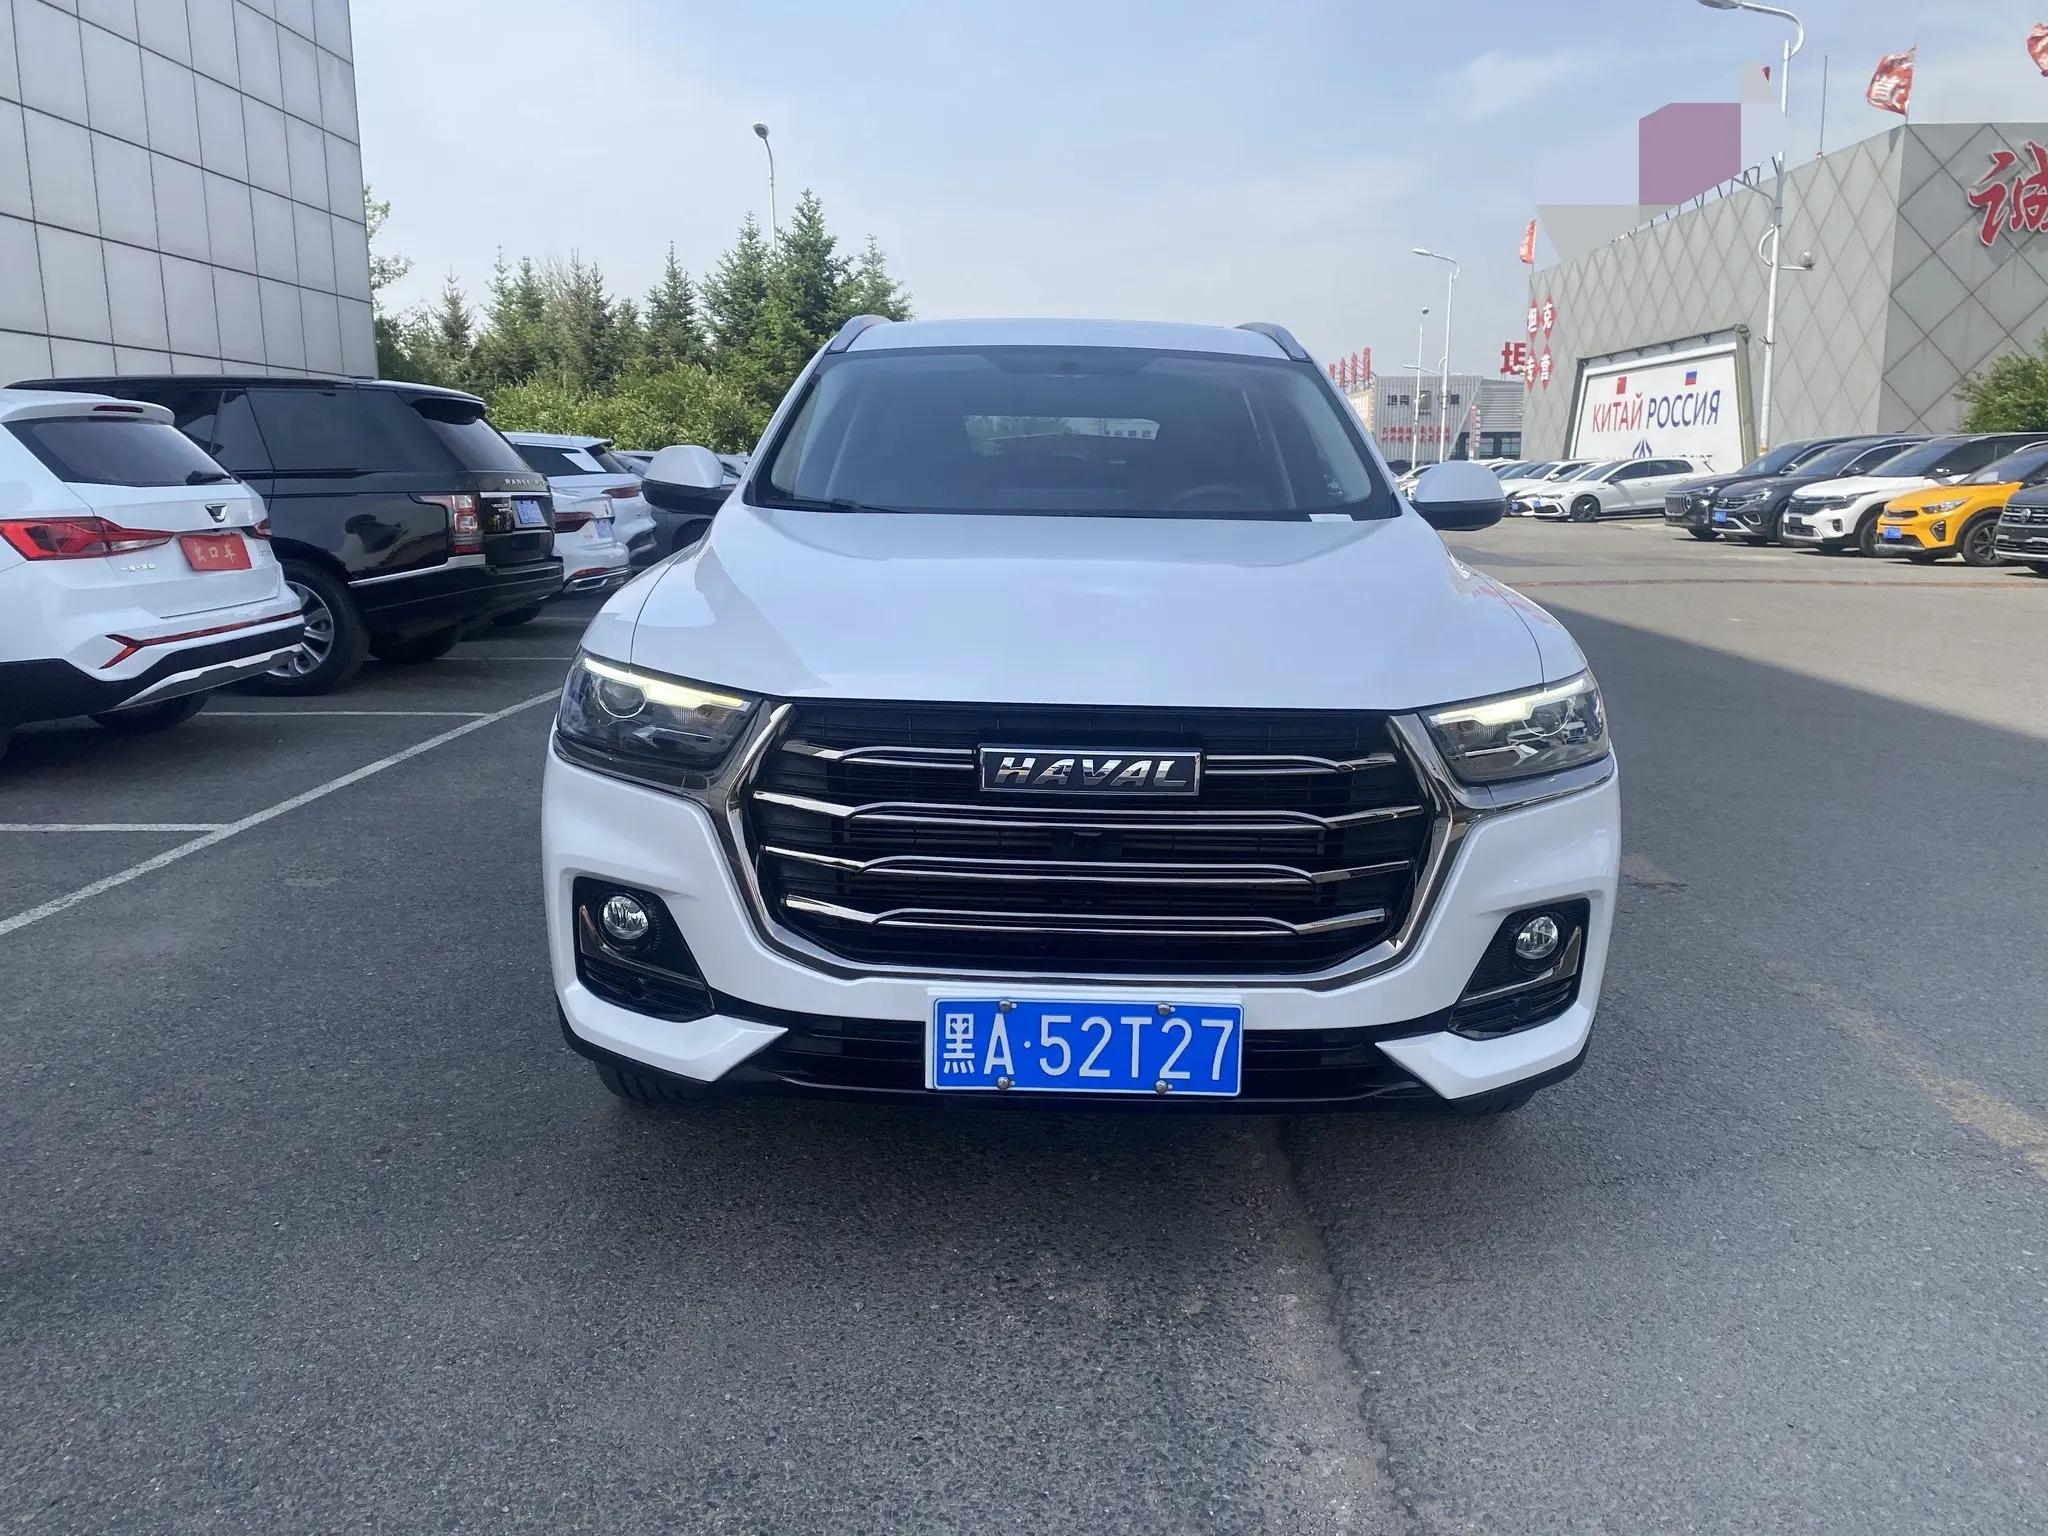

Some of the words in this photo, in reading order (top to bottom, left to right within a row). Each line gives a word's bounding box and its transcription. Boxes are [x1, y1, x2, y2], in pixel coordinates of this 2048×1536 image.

[1592, 391, 1644, 433] КИТАЙ
[1646, 389, 1721, 429] РОССИЯ
[994, 756, 1187, 787] HAVAL
